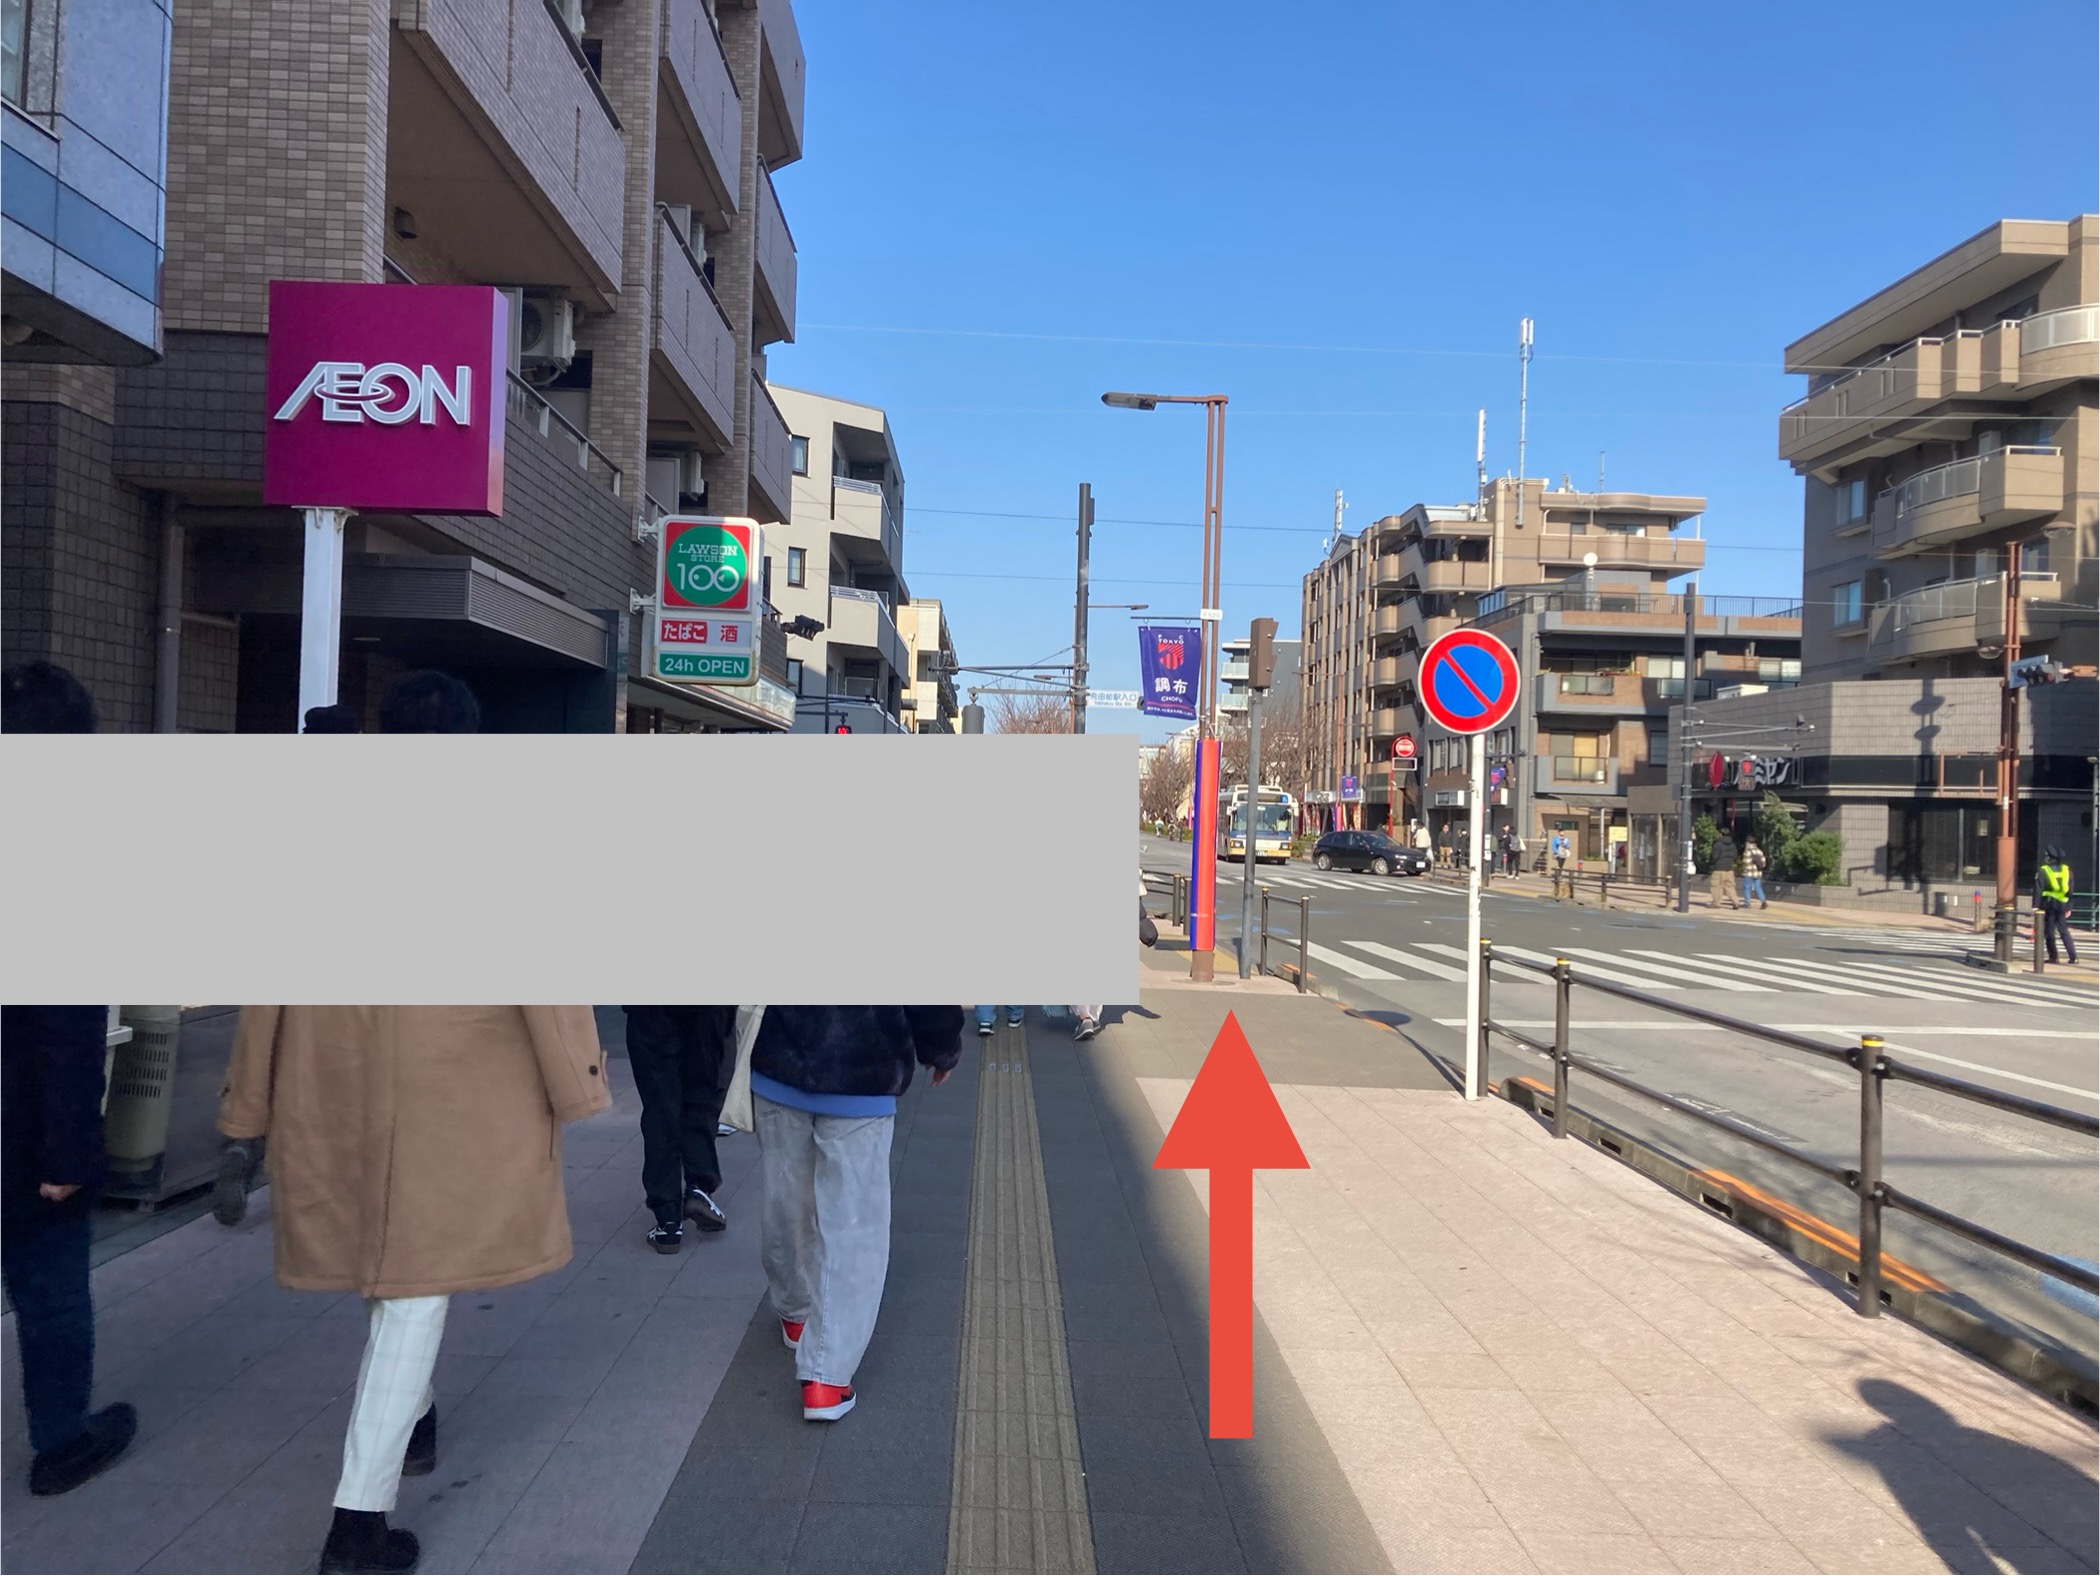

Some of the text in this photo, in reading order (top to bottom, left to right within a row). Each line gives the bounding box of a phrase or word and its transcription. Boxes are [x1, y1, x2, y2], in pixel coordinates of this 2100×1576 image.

[678, 543, 738, 556] LAWSON
[690, 554, 725, 563] STORE
[677, 563, 740, 592] 100
[663, 622, 739, 642] たばこ 酒
[664, 658, 745, 675] 24h OPEN
[1155, 677, 1188, 694] 調布
[1161, 695, 1183, 703] CHOFU
